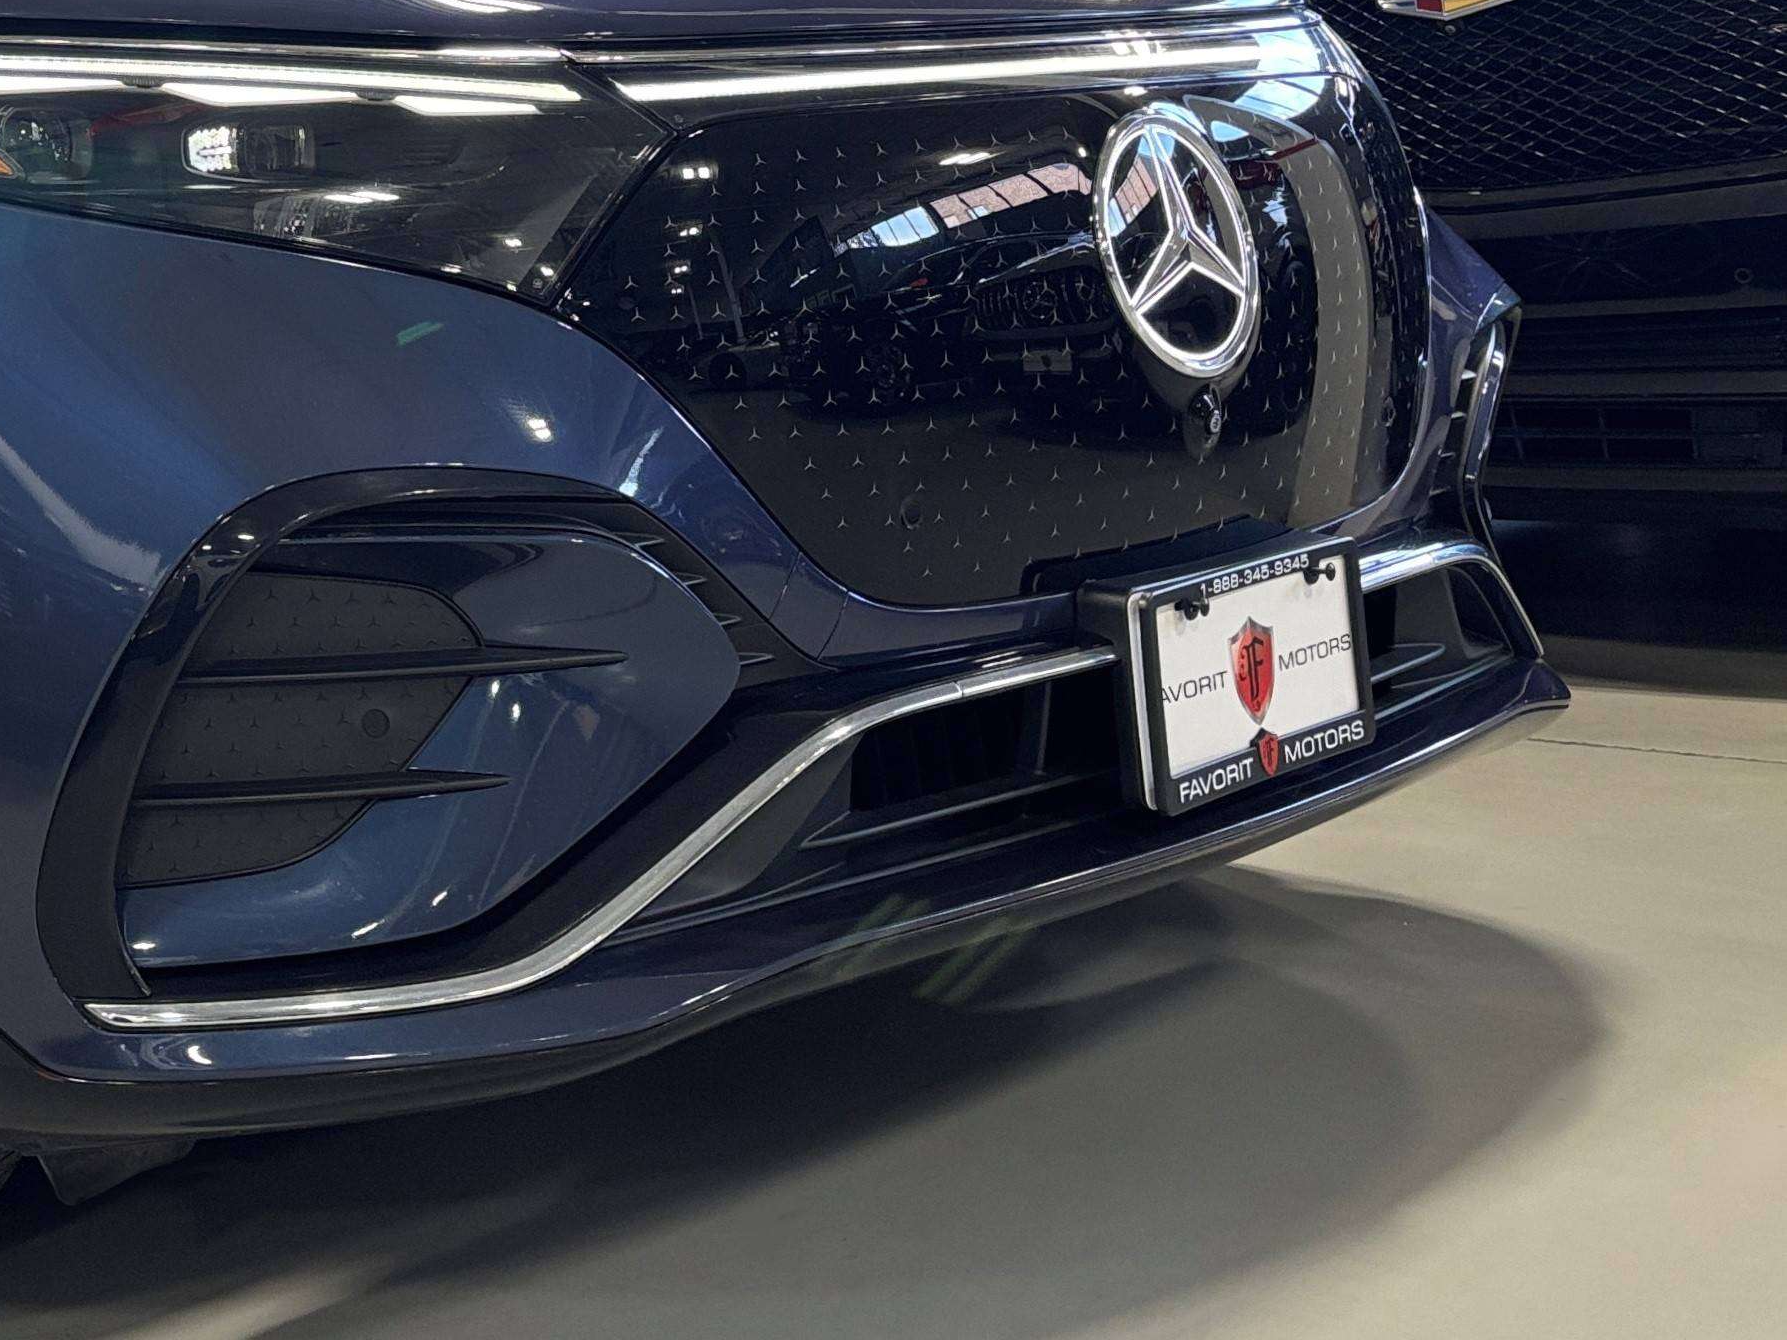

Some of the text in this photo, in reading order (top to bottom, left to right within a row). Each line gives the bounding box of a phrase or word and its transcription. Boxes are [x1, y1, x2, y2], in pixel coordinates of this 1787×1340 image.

[1200, 553, 1310, 595] 1-888-345-9345
[1161, 670, 1228, 705] AVORIT
[1278, 633, 1352, 672] MOTORS
[1179, 757, 1254, 804] FAVORIT
[1284, 720, 1365, 764] MOTORS
